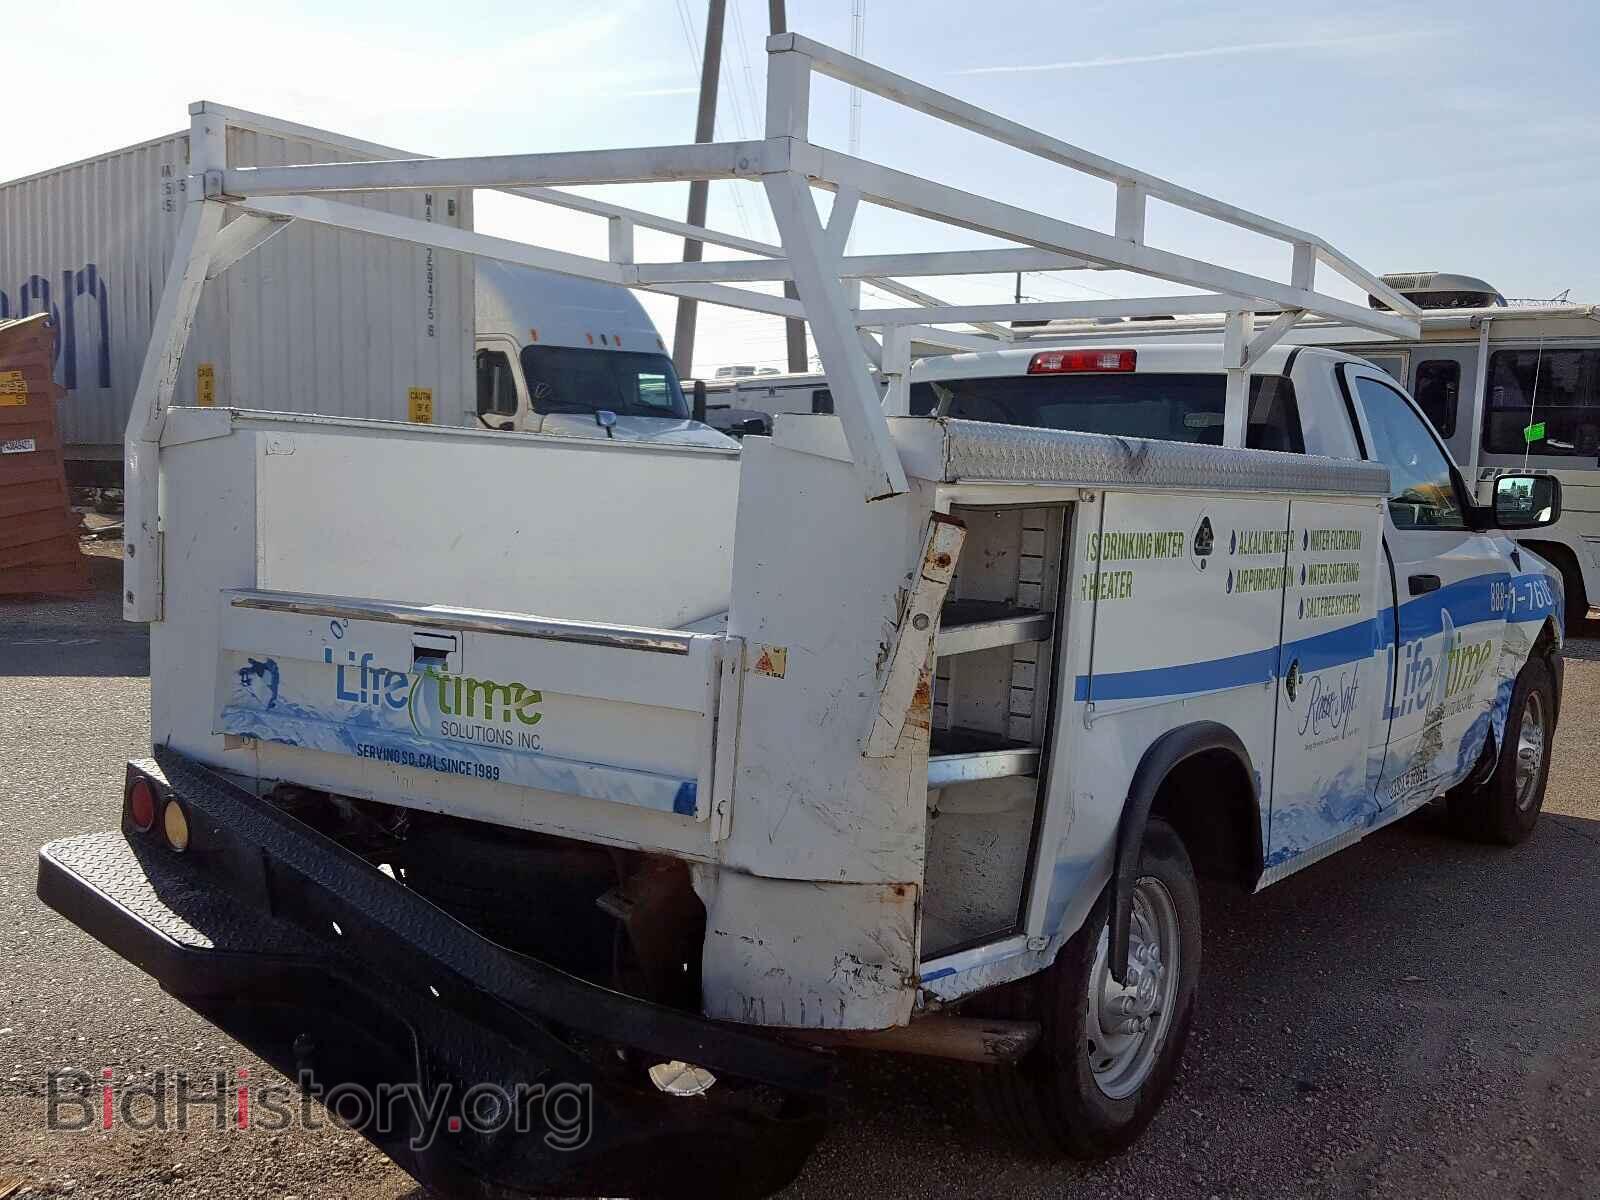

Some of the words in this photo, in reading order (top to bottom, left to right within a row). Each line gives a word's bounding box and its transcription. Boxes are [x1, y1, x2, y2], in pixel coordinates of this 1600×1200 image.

[1102, 532, 1152, 561] DRINKING
[1154, 531, 1184, 558] WATER
[1238, 530, 1273, 555] ALKALINE
[441, 720, 514, 746] SOLUTIONS
[518, 731, 544, 751] INC.
[442, 758, 473, 777] SINCE
[473, 763, 501, 781] 1989
